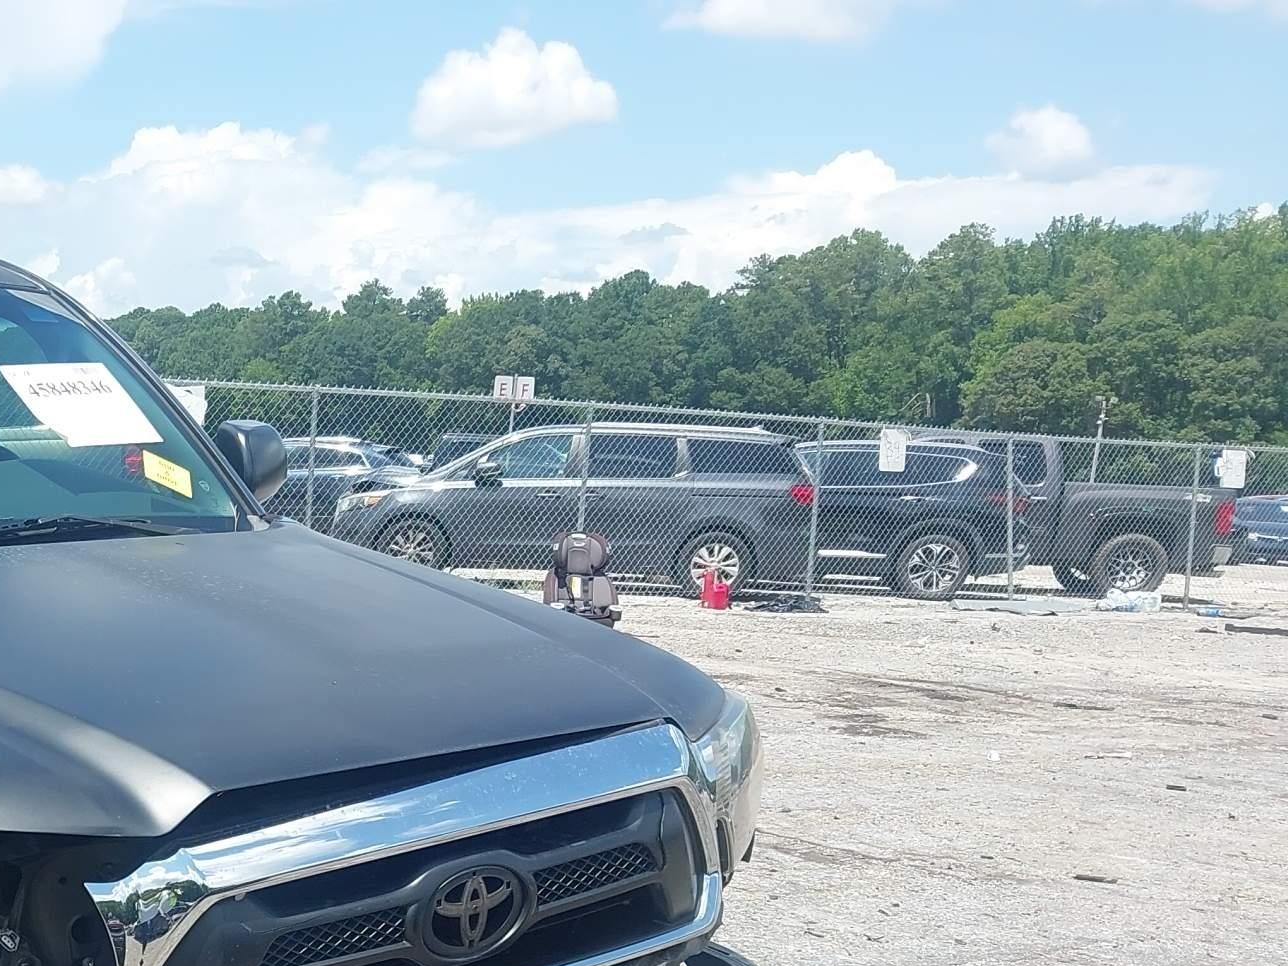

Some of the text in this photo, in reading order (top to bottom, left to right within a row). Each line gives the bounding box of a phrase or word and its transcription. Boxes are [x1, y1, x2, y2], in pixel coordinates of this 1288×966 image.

[27, 379, 113, 398] 45848346
[499, 382, 508, 397] E
[521, 383, 530, 398] F
